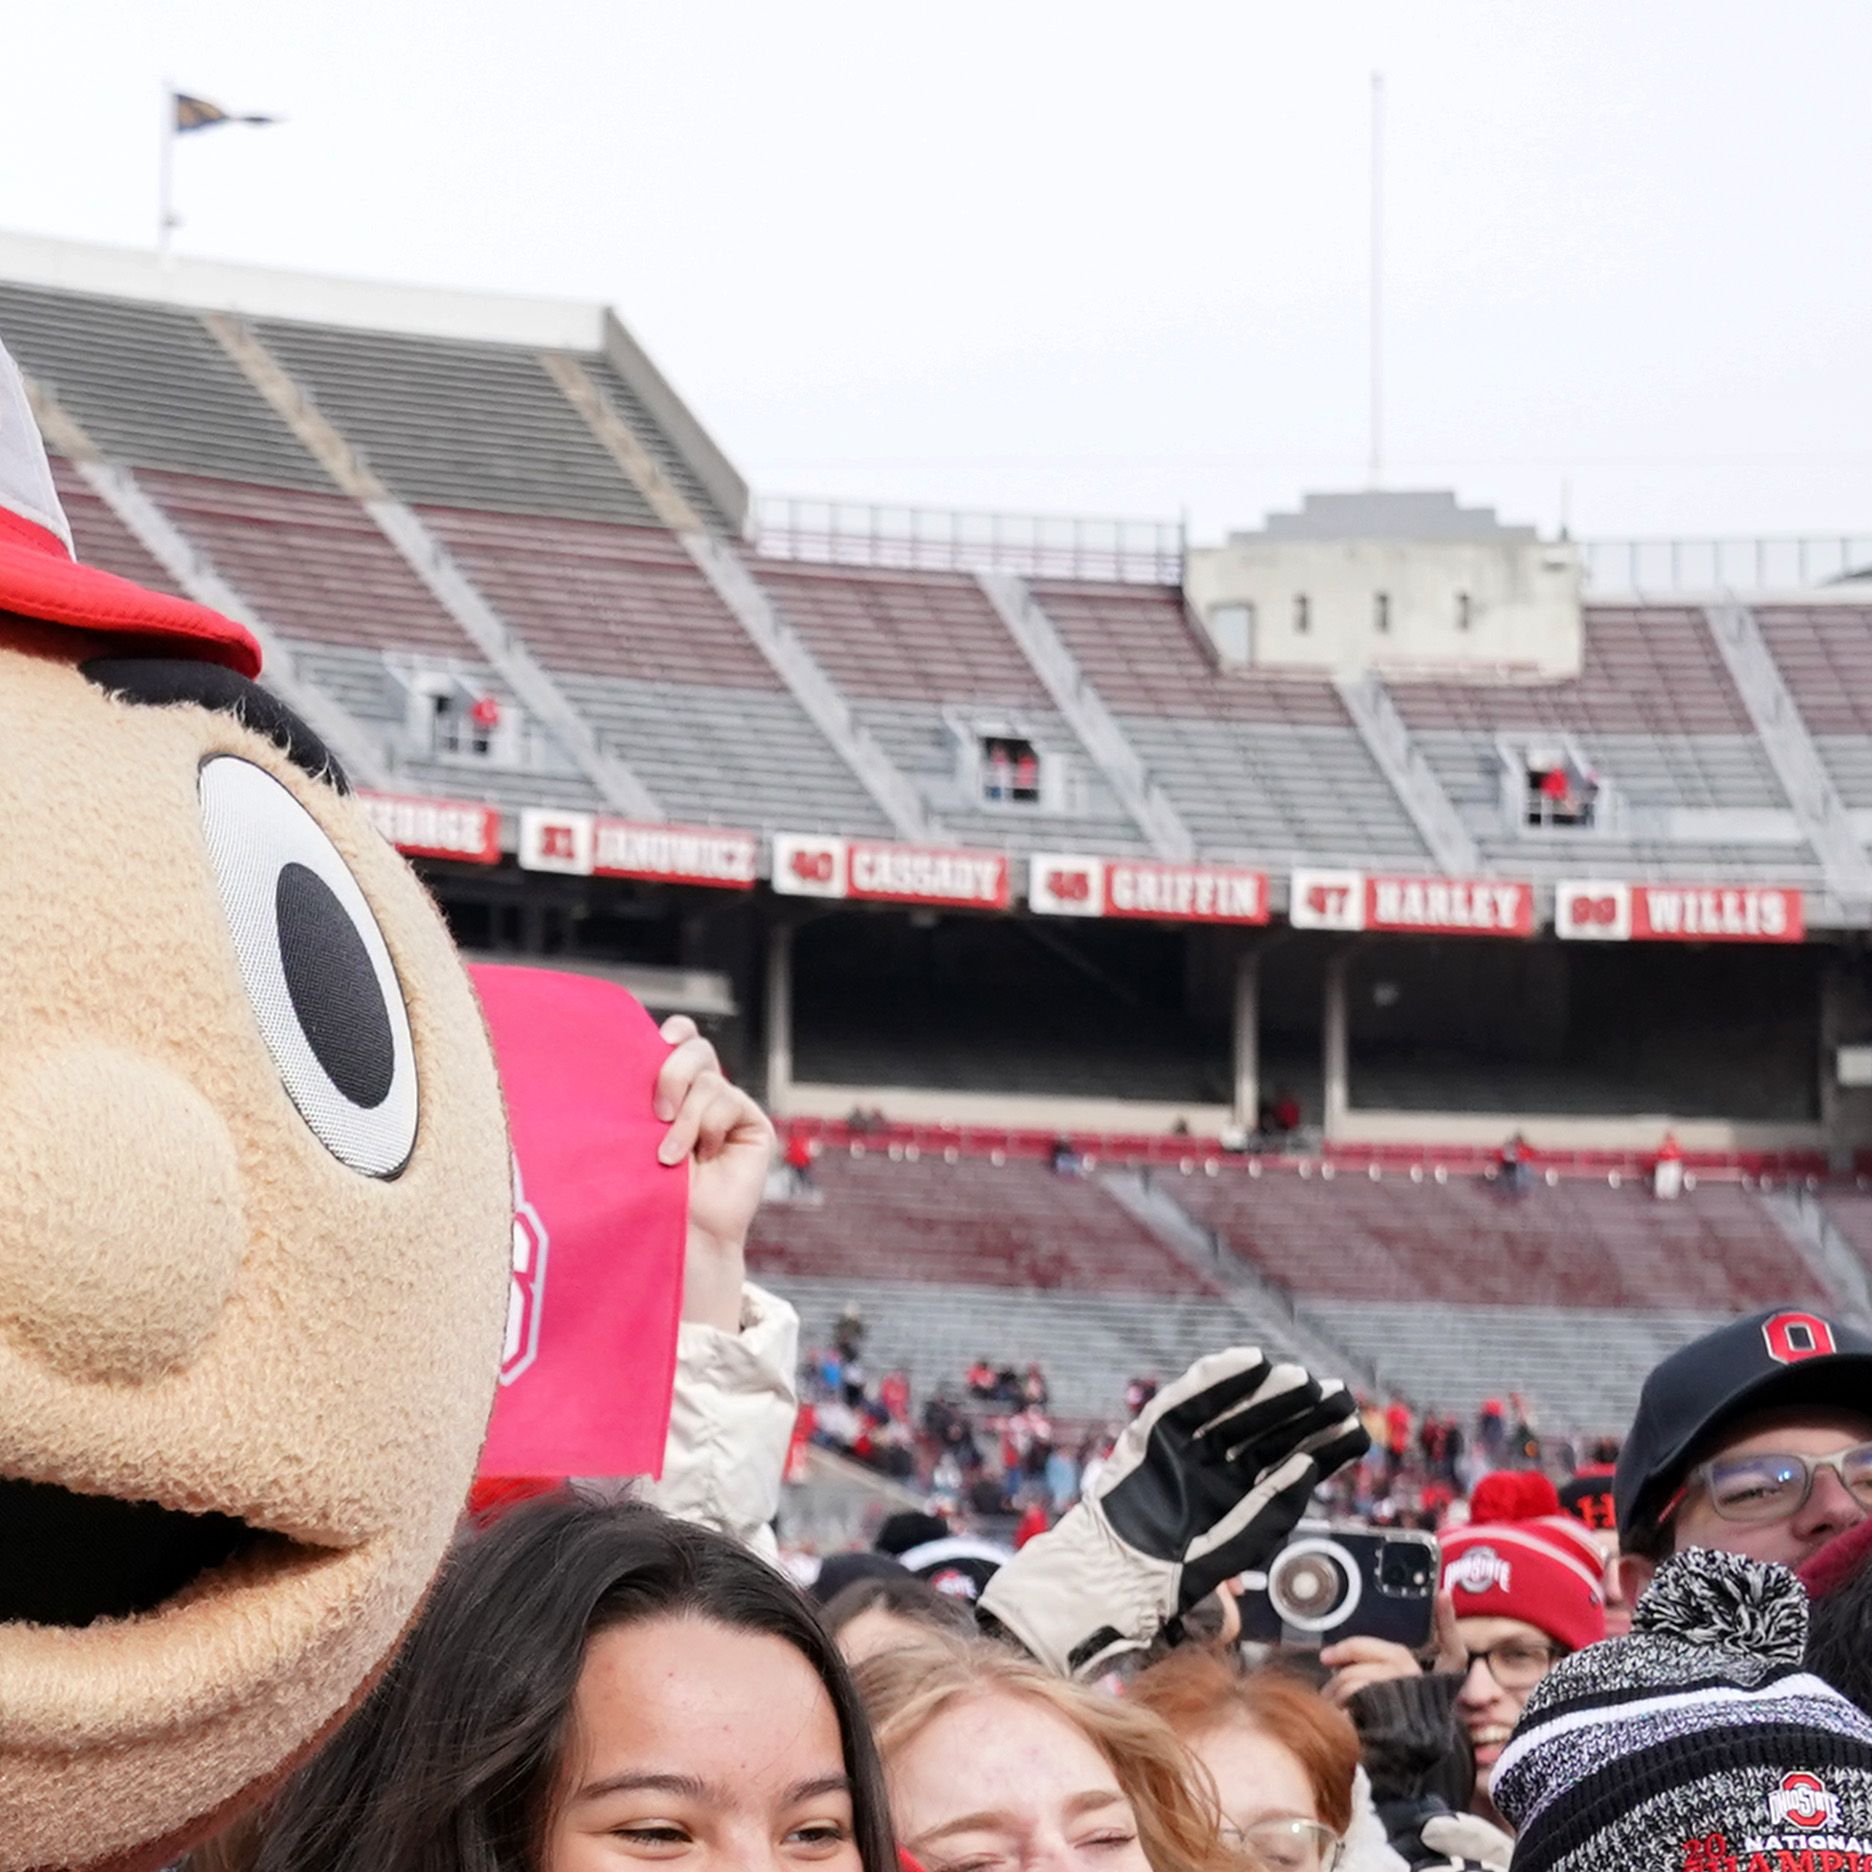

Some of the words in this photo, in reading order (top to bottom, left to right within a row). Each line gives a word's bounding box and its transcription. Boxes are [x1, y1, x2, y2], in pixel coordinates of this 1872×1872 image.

[1373, 881, 1522, 929] HARLEY
[1645, 890, 1787, 936] WILLIS
[1682, 1832, 1726, 1867] 20
